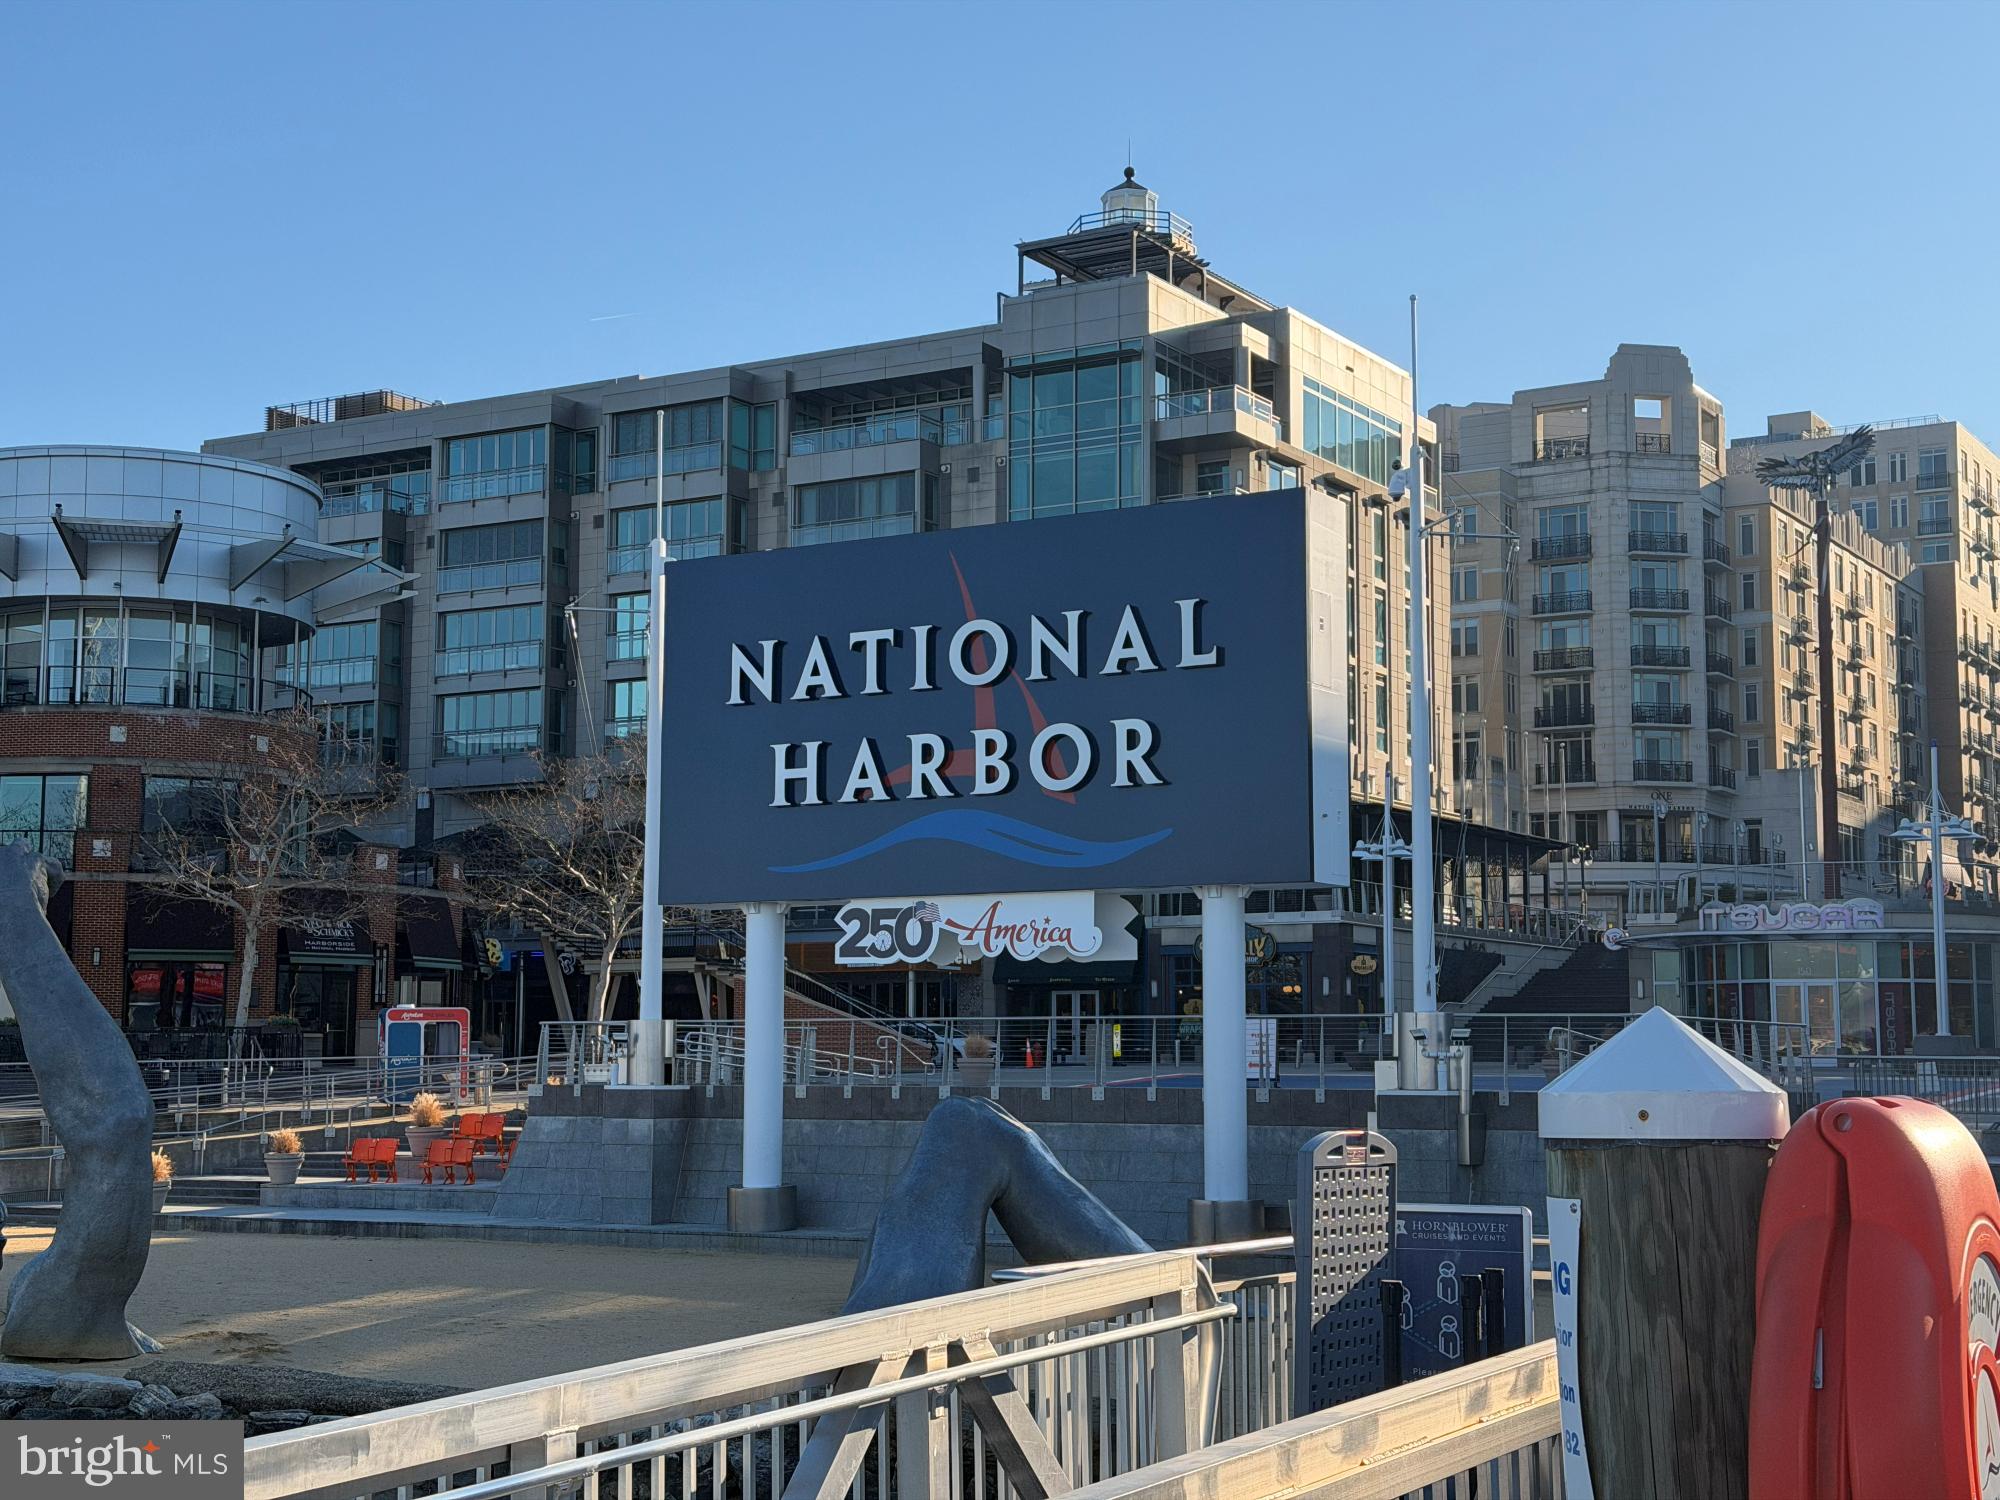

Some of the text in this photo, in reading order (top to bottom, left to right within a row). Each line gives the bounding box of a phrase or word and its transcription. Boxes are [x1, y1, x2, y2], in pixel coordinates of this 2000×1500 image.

[726, 598, 1221, 706] NATIONAL
[770, 719, 1165, 807] HARBOR
[1651, 790, 1673, 802] ONE
[839, 900, 1097, 958] 250 America
[1700, 903, 1884, 931] IT'SUGAR
[1412, 1232, 1448, 1240] CRUISES
[1451, 1233, 1469, 1241] AND
[1413, 1221, 1506, 1232] HORNBLOWER
